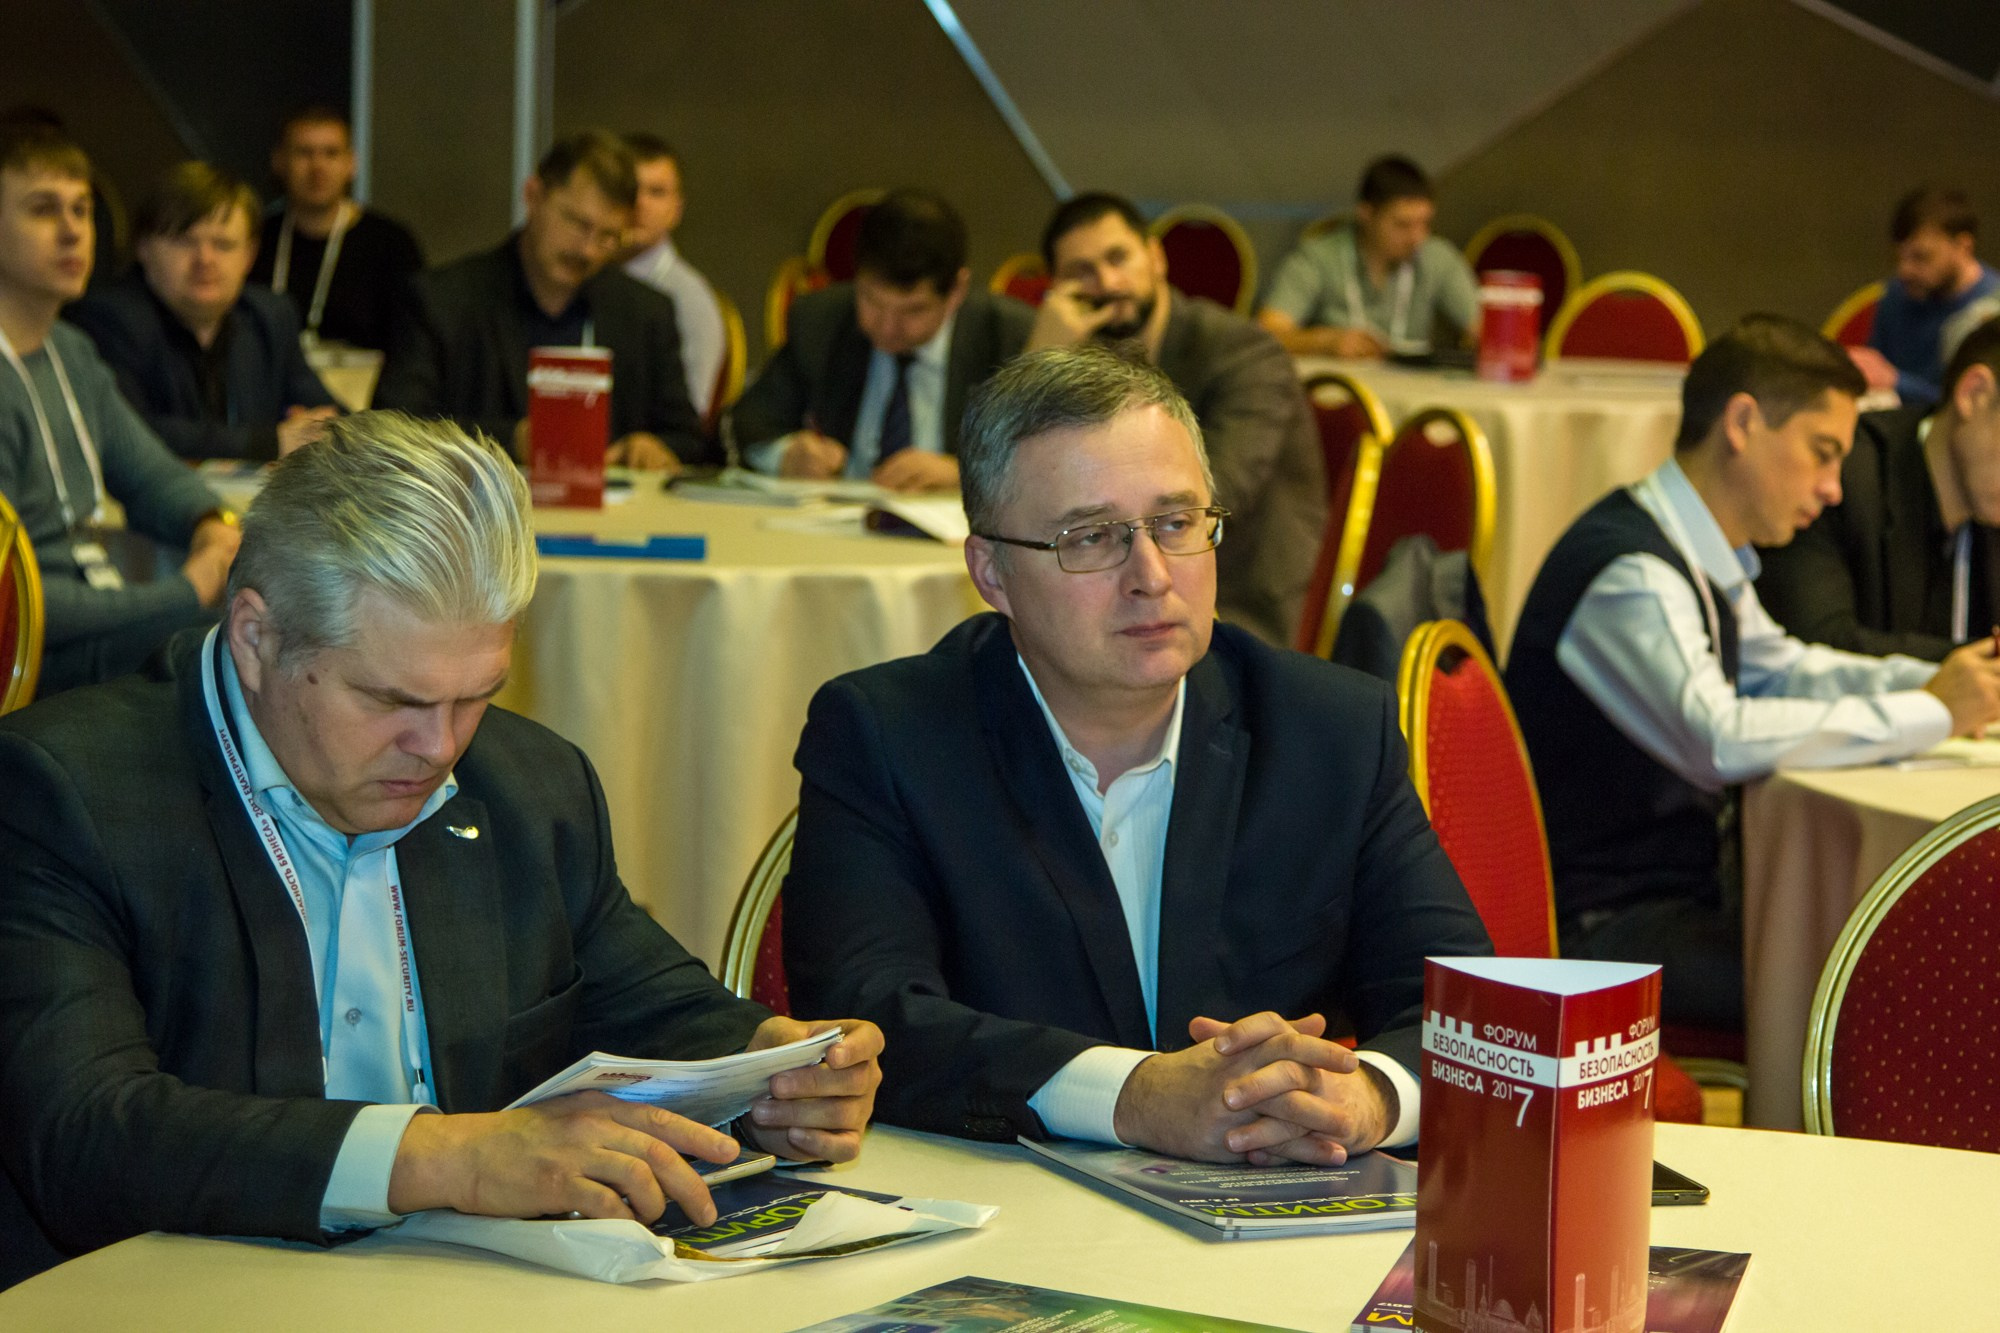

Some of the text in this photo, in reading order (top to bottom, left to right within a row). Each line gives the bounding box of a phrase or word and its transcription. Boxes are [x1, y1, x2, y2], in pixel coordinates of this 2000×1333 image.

[219, 728, 253, 796] ЕКАТЕРИНБУРГ
[261, 818, 288, 867] БИЗНЕСА»
[390, 885, 415, 1012] WWW.FORUM-SECURITY.RU
[1483, 1024, 1537, 1052] ФОРУМ
[1628, 1015, 1656, 1040] ФОРУМ
[1433, 1032, 1535, 1078] БЕЗОПАСНОСТЬ
[1580, 1041, 1654, 1080] БЕЗОПАСНОСТЬ
[1432, 1059, 1535, 1128] БИЗНЕСА 2017
[1577, 1067, 1654, 1110] БИЗНЕСА 2017
[677, 1198, 821, 1247] ОРИТМ
[1201, 1196, 1417, 1216] ГОРИТМ
